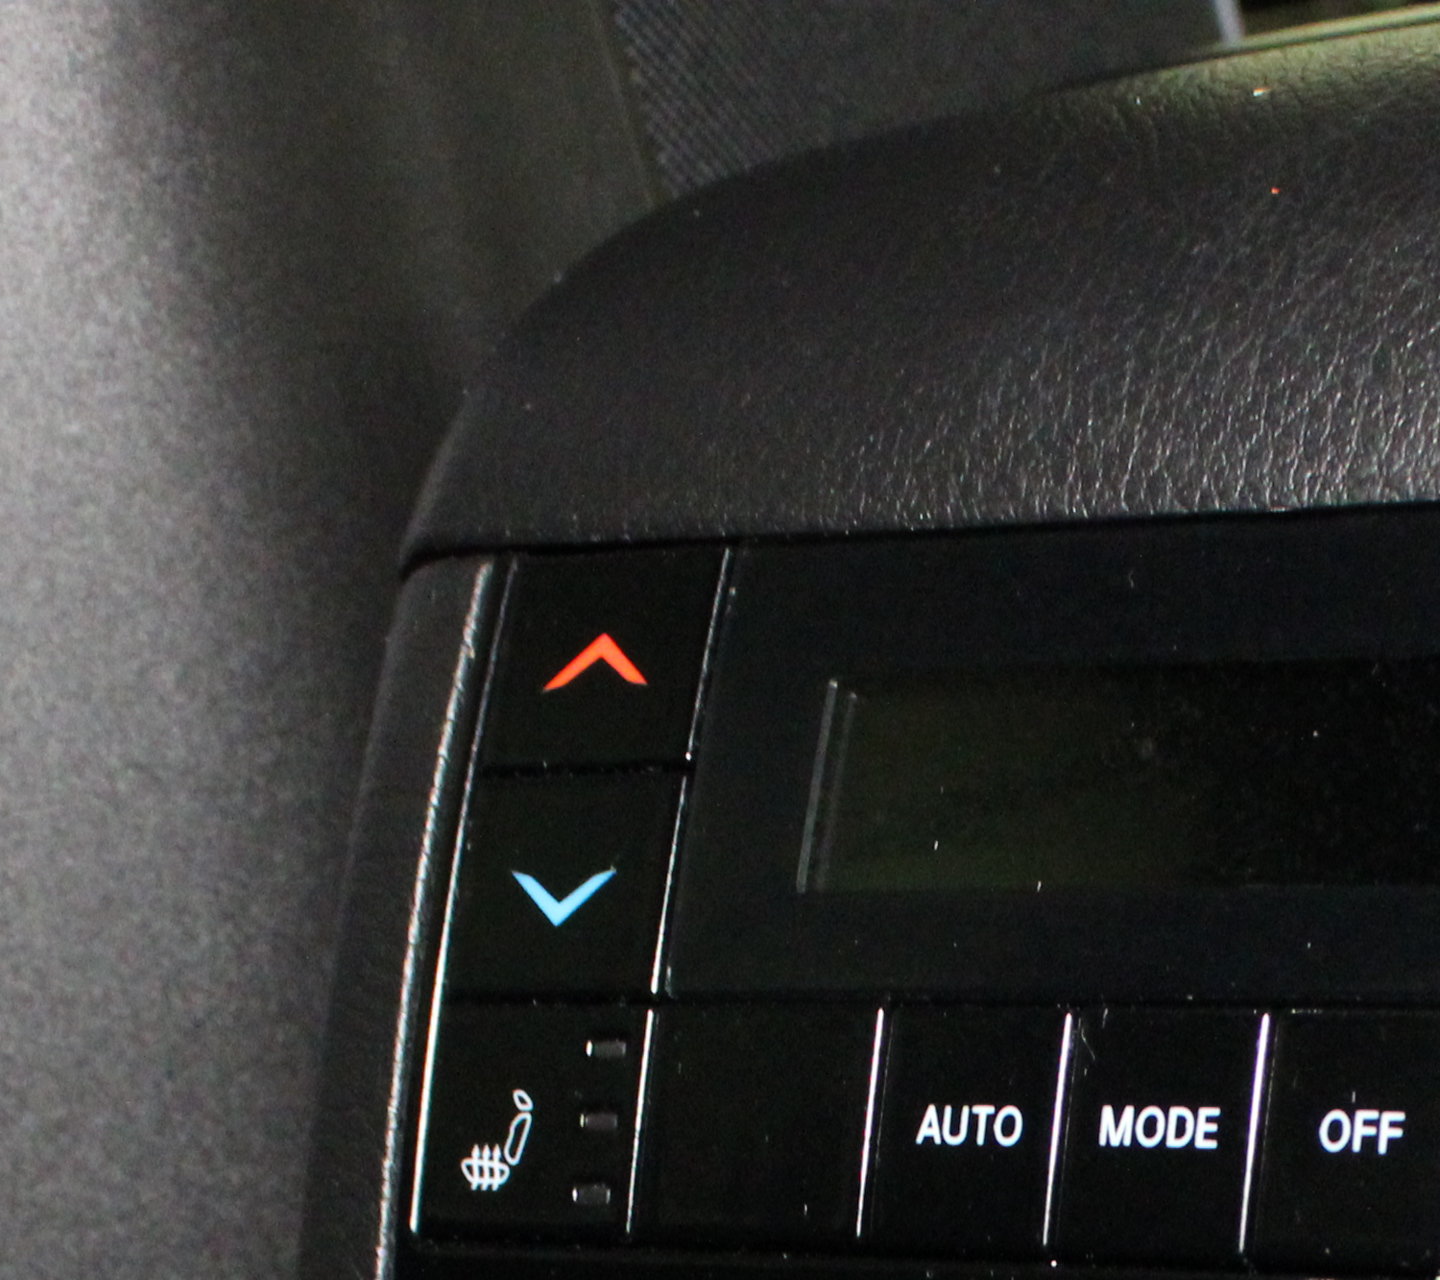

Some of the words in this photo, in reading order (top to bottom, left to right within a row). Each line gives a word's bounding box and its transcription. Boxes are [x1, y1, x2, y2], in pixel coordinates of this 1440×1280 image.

[915, 1103, 1024, 1147] AUTO
[1098, 1104, 1222, 1150] MODE
[1318, 1108, 1407, 1156] OFF
